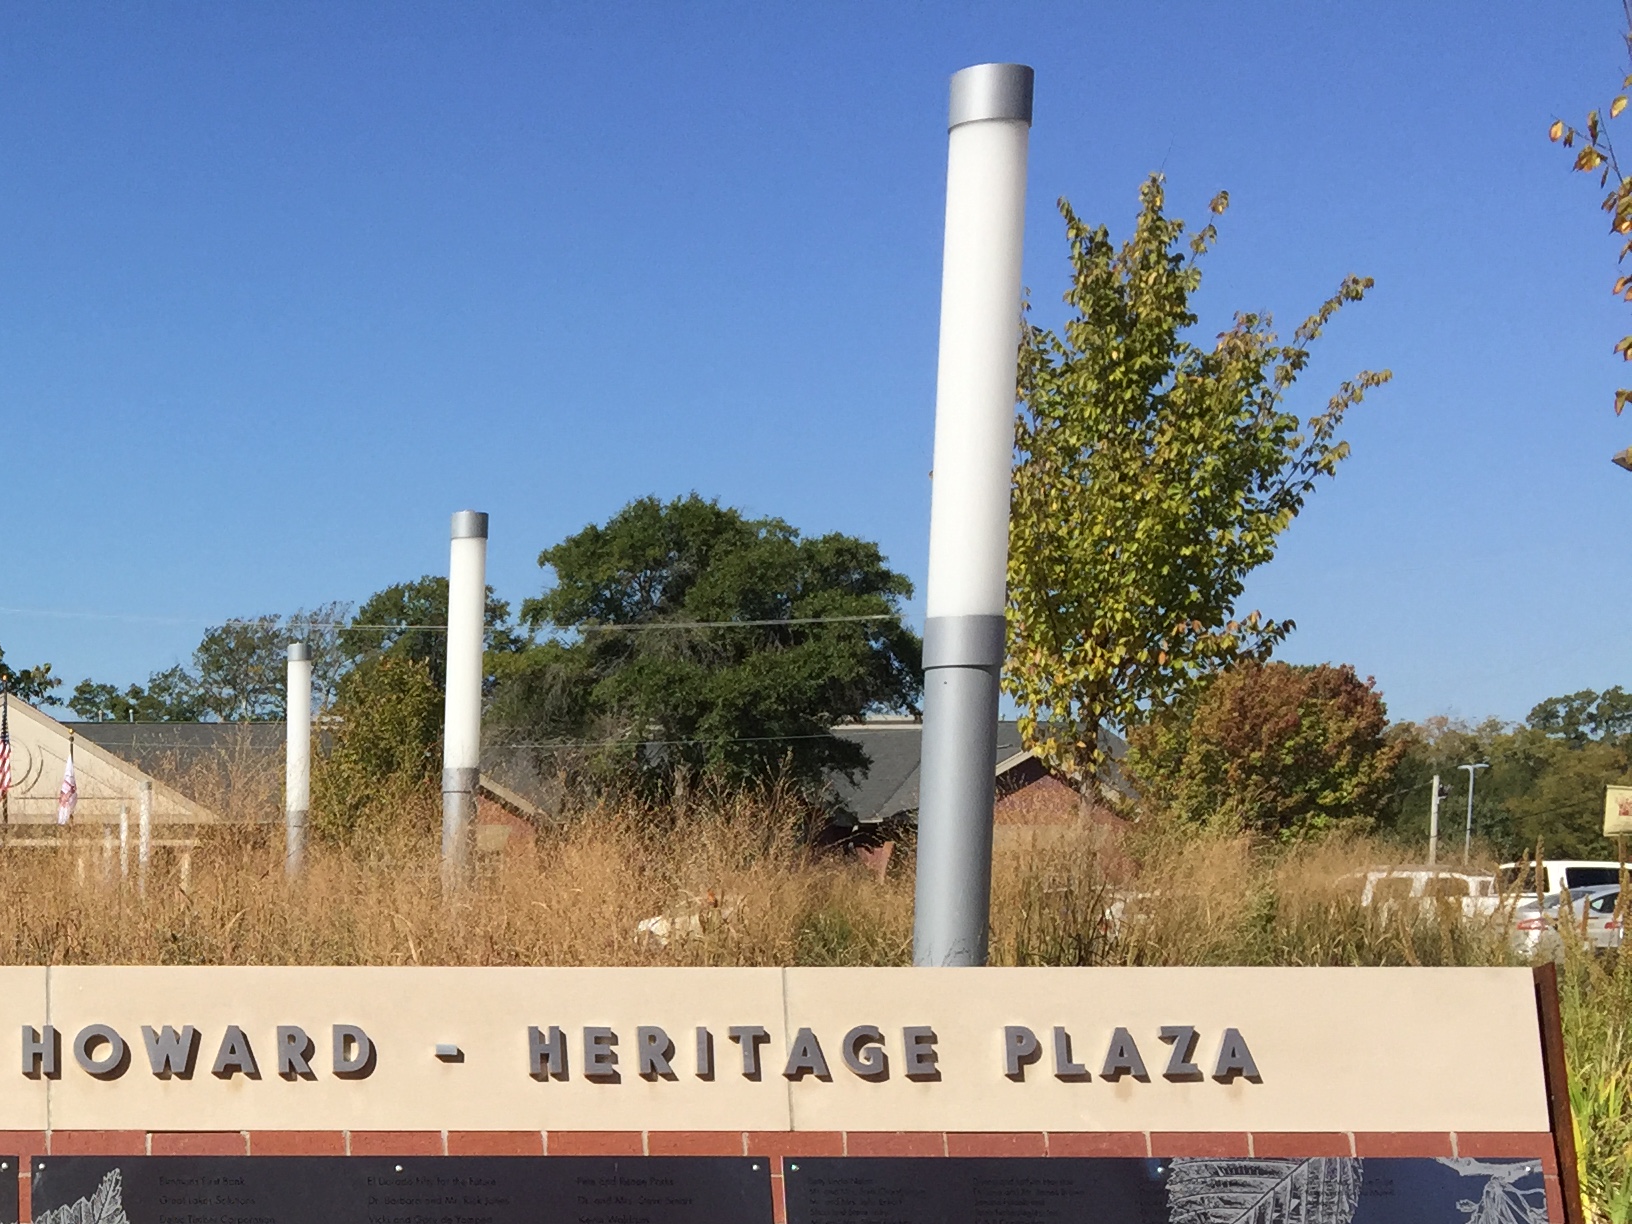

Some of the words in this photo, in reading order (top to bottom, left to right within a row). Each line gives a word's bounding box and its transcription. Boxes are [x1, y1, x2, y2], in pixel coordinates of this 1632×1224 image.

[20, 1023, 376, 1081] HOWARD
[435, 1043, 465, 1064] -
[528, 1024, 942, 1083] HERITAGE
[1004, 1024, 1264, 1084] PLAZA
